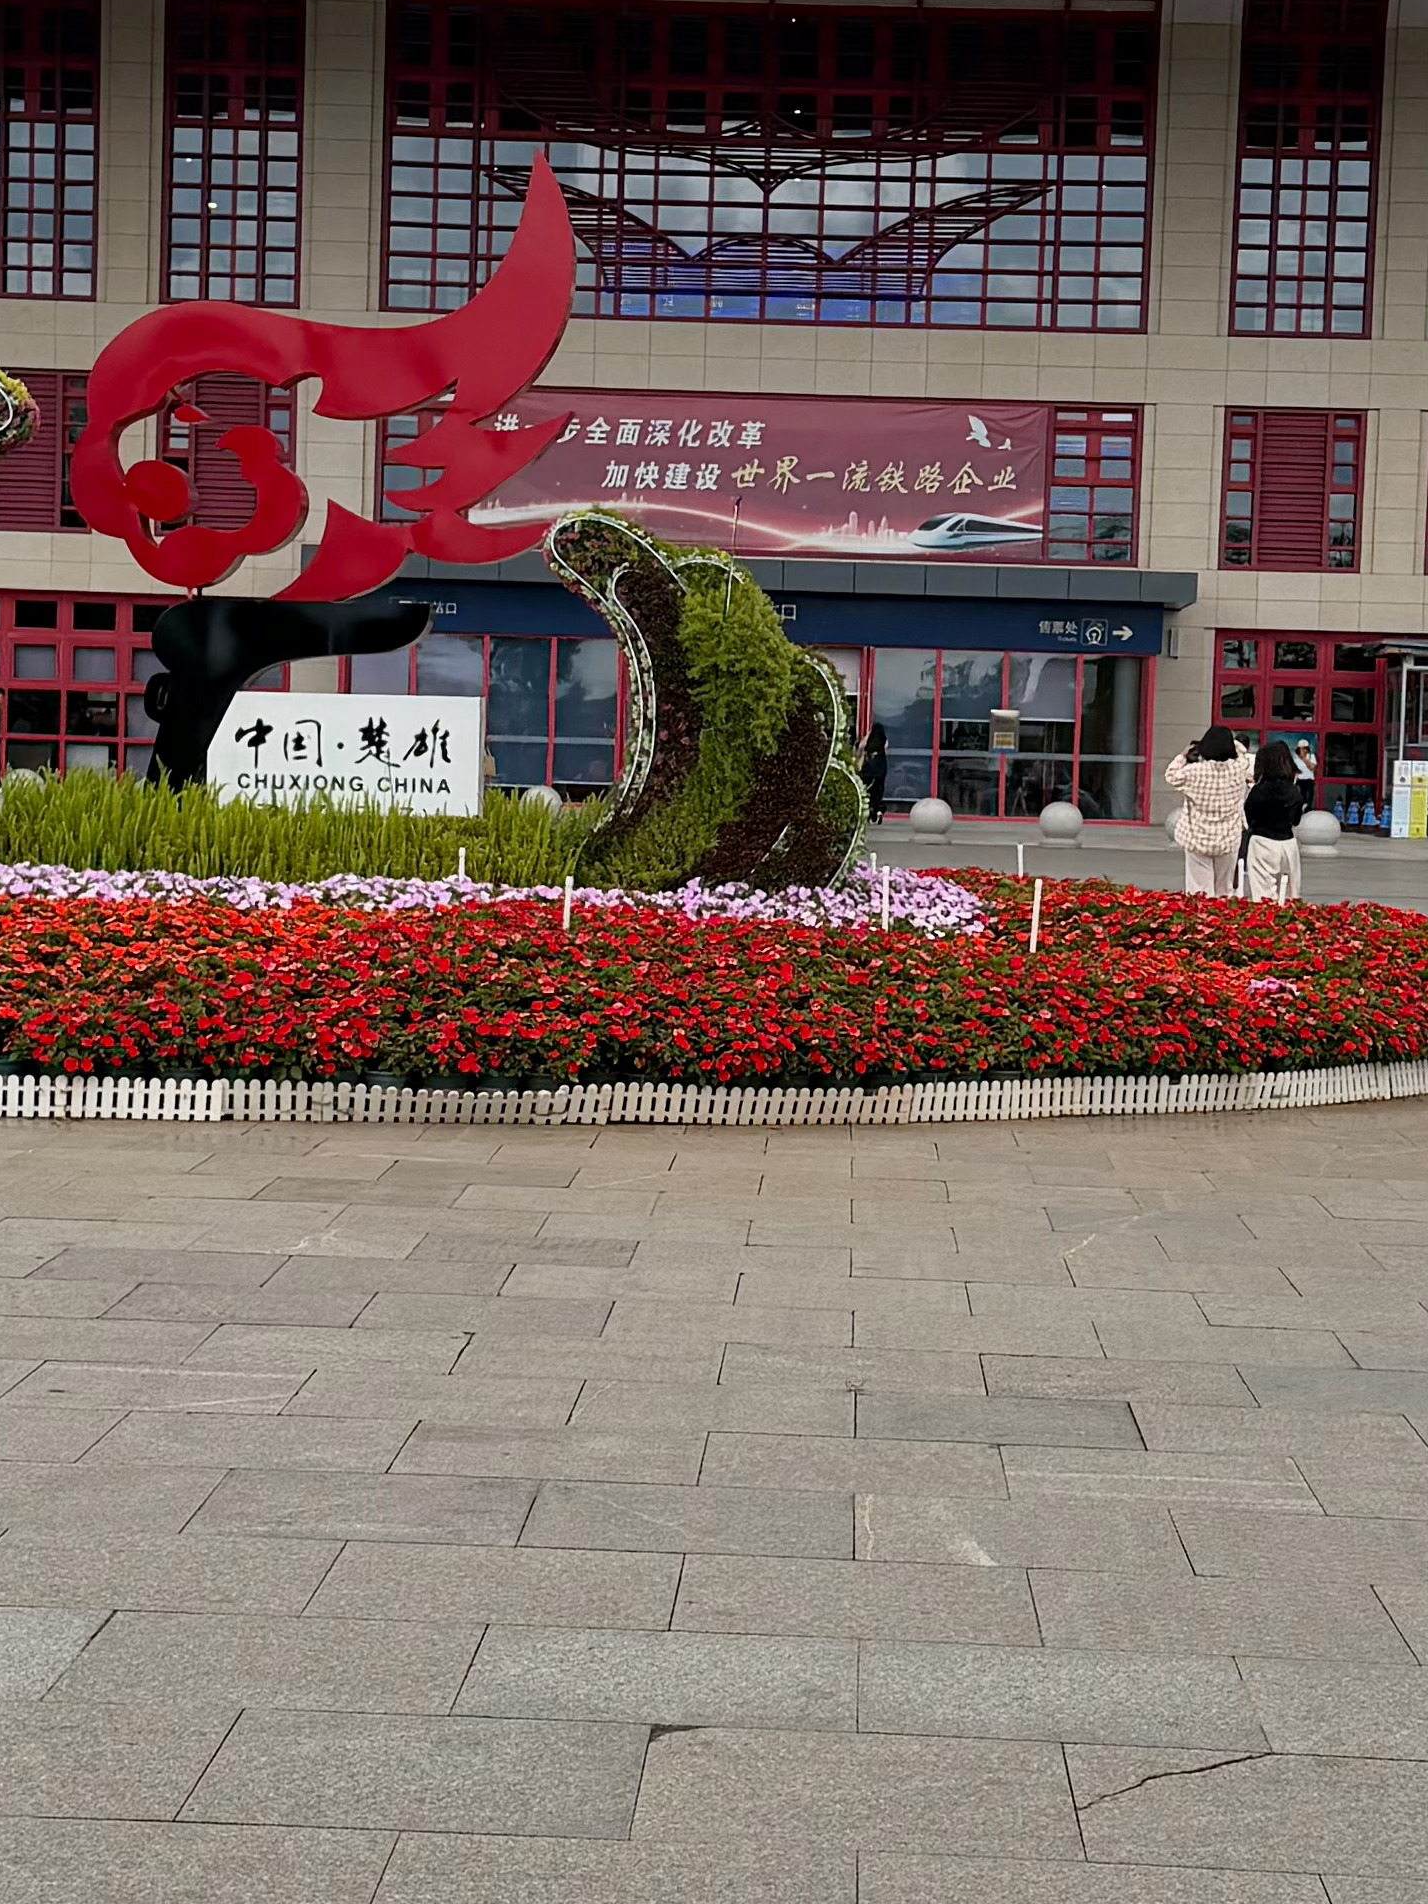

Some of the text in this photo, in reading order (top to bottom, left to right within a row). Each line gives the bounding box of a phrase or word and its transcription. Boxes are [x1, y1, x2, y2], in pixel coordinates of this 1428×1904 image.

[601, 455, 1017, 494] 加快建设世界一流铁路企业
[236, 772, 451, 795] CHUXIONG CHINA
